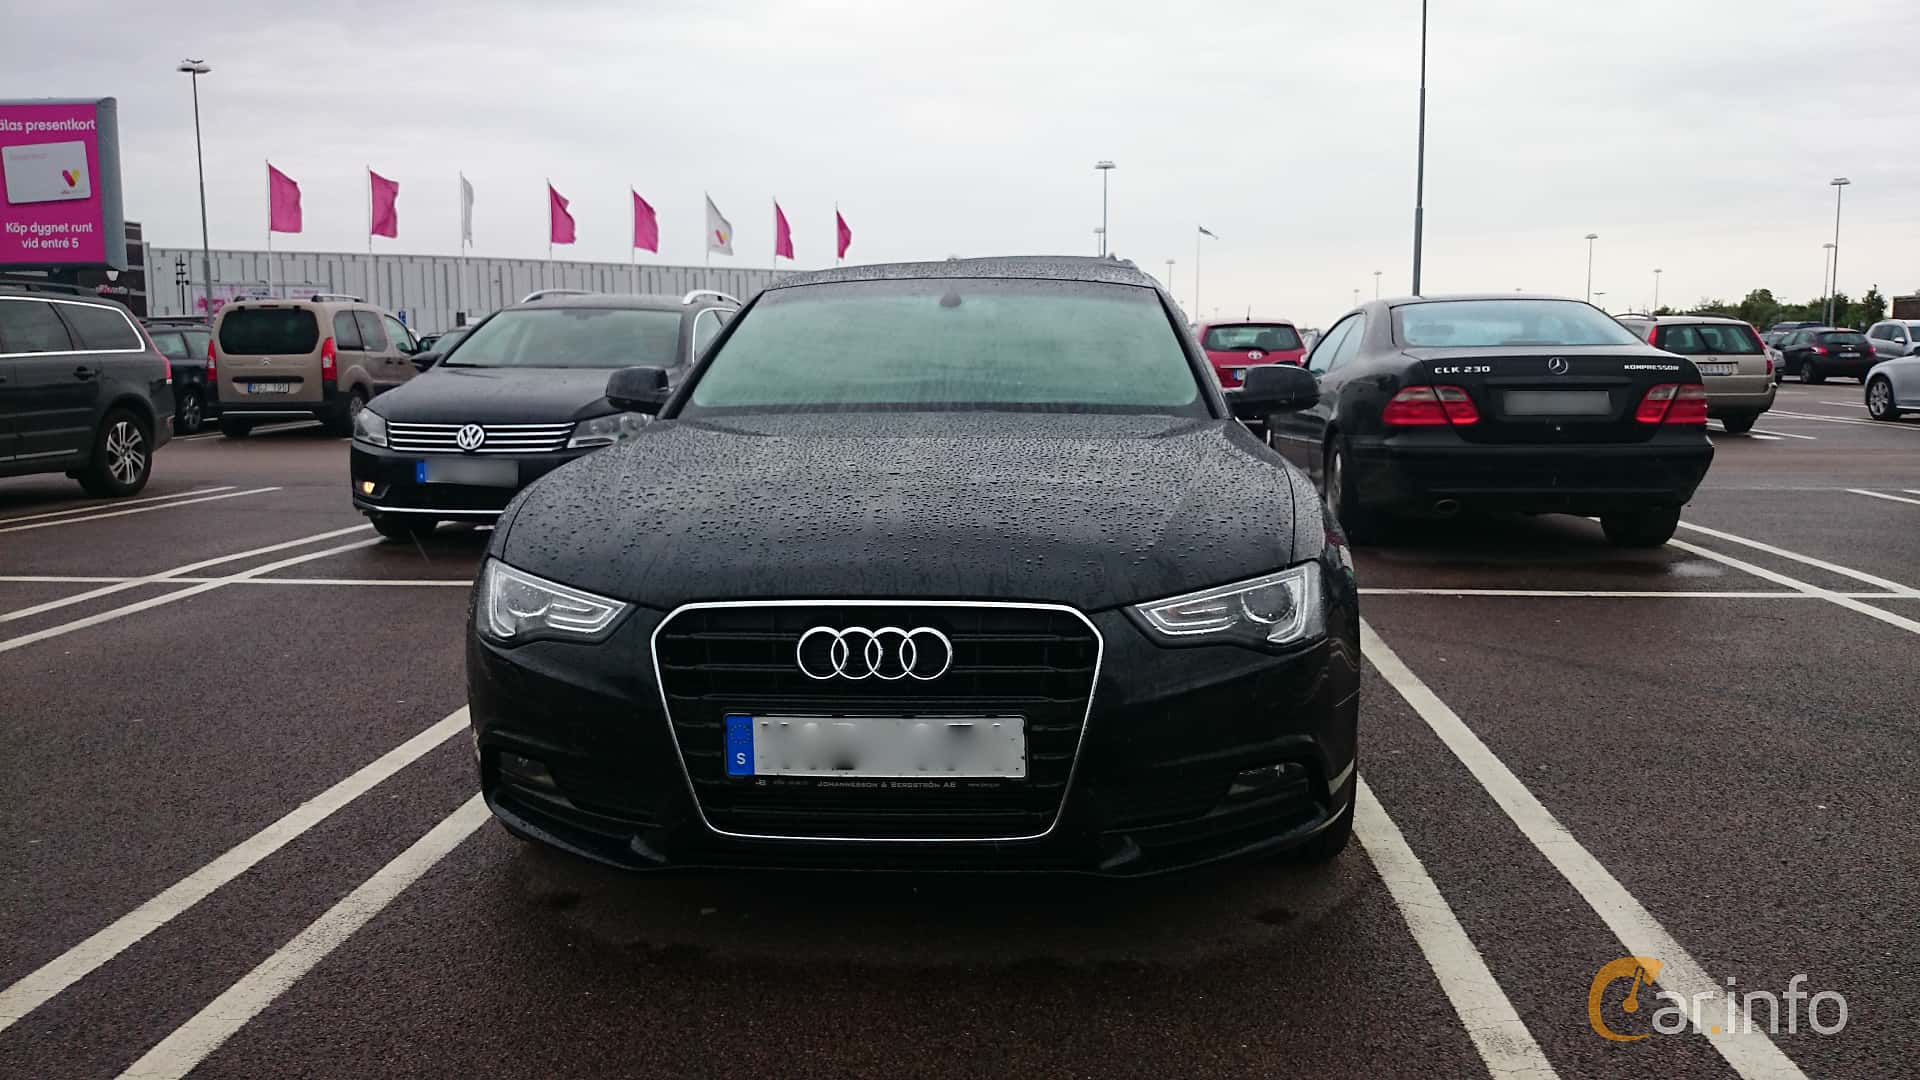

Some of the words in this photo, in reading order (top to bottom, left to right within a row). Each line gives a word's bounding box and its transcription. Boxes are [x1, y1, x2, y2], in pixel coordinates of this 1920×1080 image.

[26, 118, 96, 134] presentkort
[6, 222, 28, 235] Köp
[30, 222, 69, 235] dygnet
[71, 223, 93, 232] runt
[22, 238, 39, 248] vid
[41, 237, 69, 248] entré
[71, 238, 79, 248] 5
[1434, 366, 1460, 374] CLK
[1463, 365, 1491, 373] 230
[736, 752, 746, 765] S
